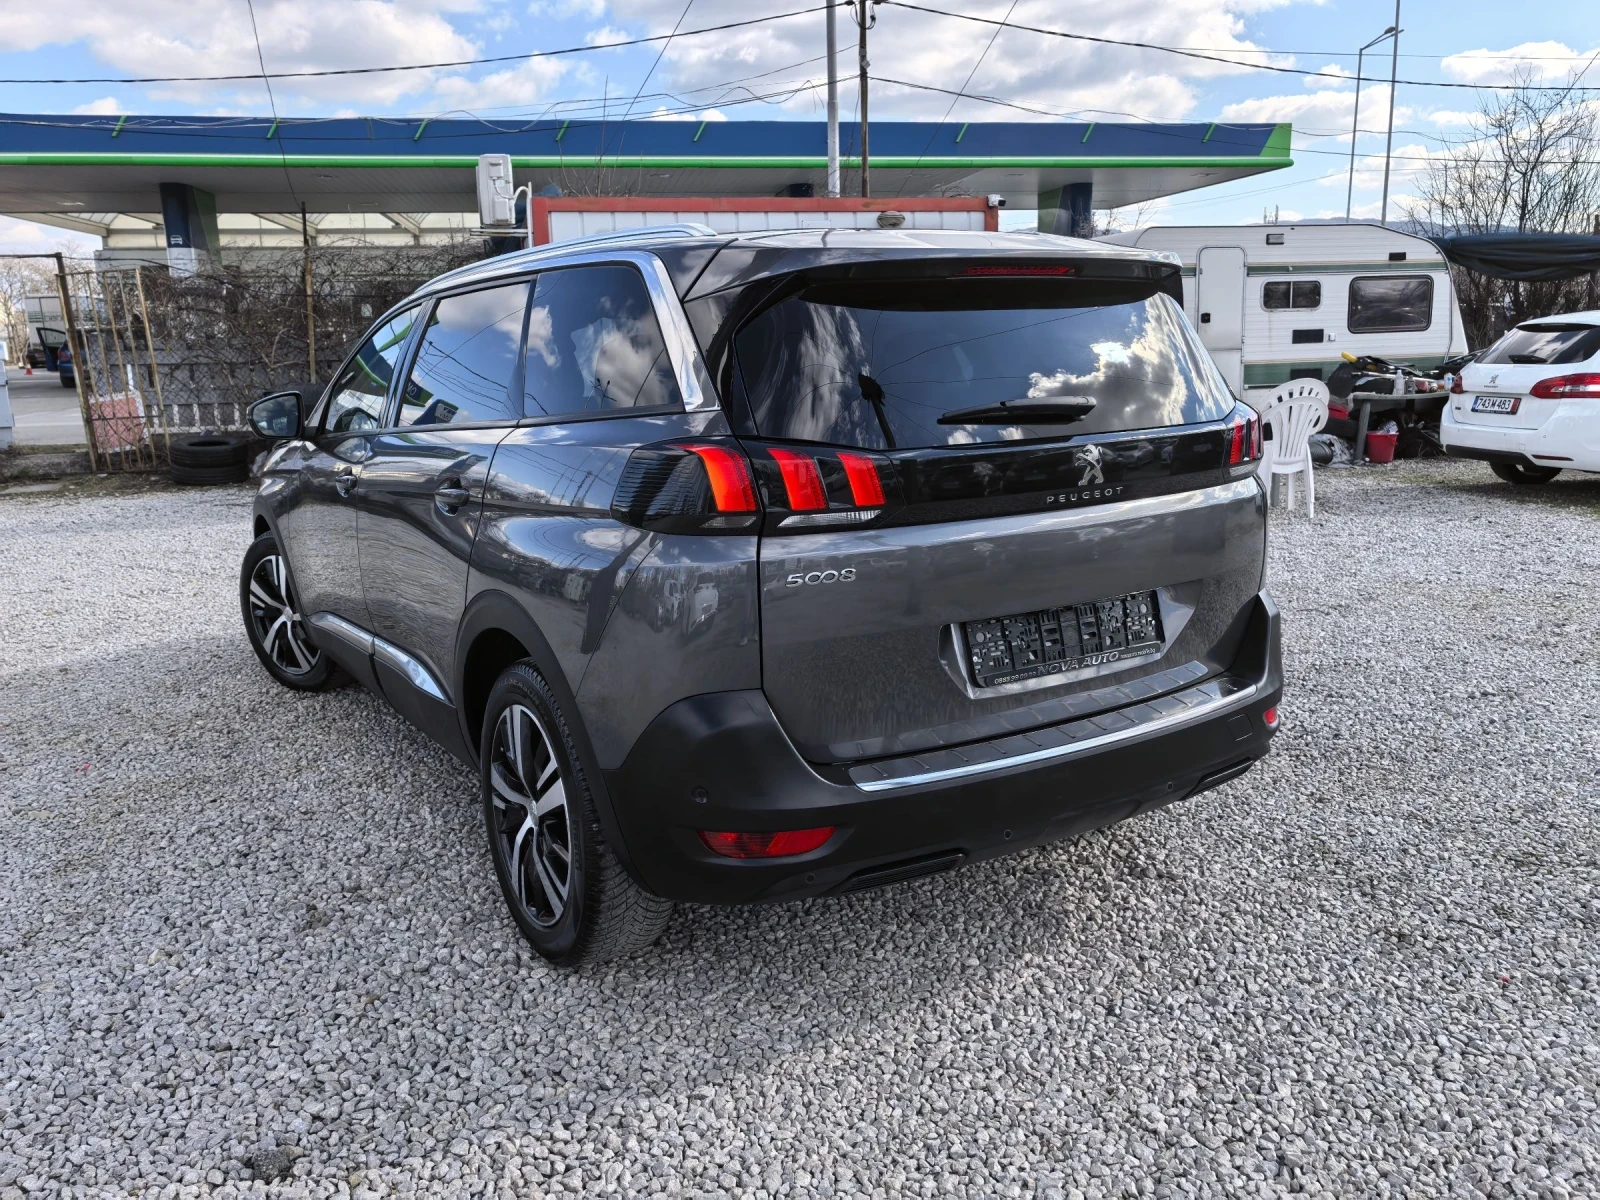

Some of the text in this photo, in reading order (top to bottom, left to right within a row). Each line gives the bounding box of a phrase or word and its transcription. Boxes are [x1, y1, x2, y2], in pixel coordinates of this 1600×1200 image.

[1046, 486, 1123, 504] PEUGEOT
[785, 568, 857, 587] 5008
[1037, 659, 1079, 676] NOVA
[1081, 651, 1119, 667] AUTO
